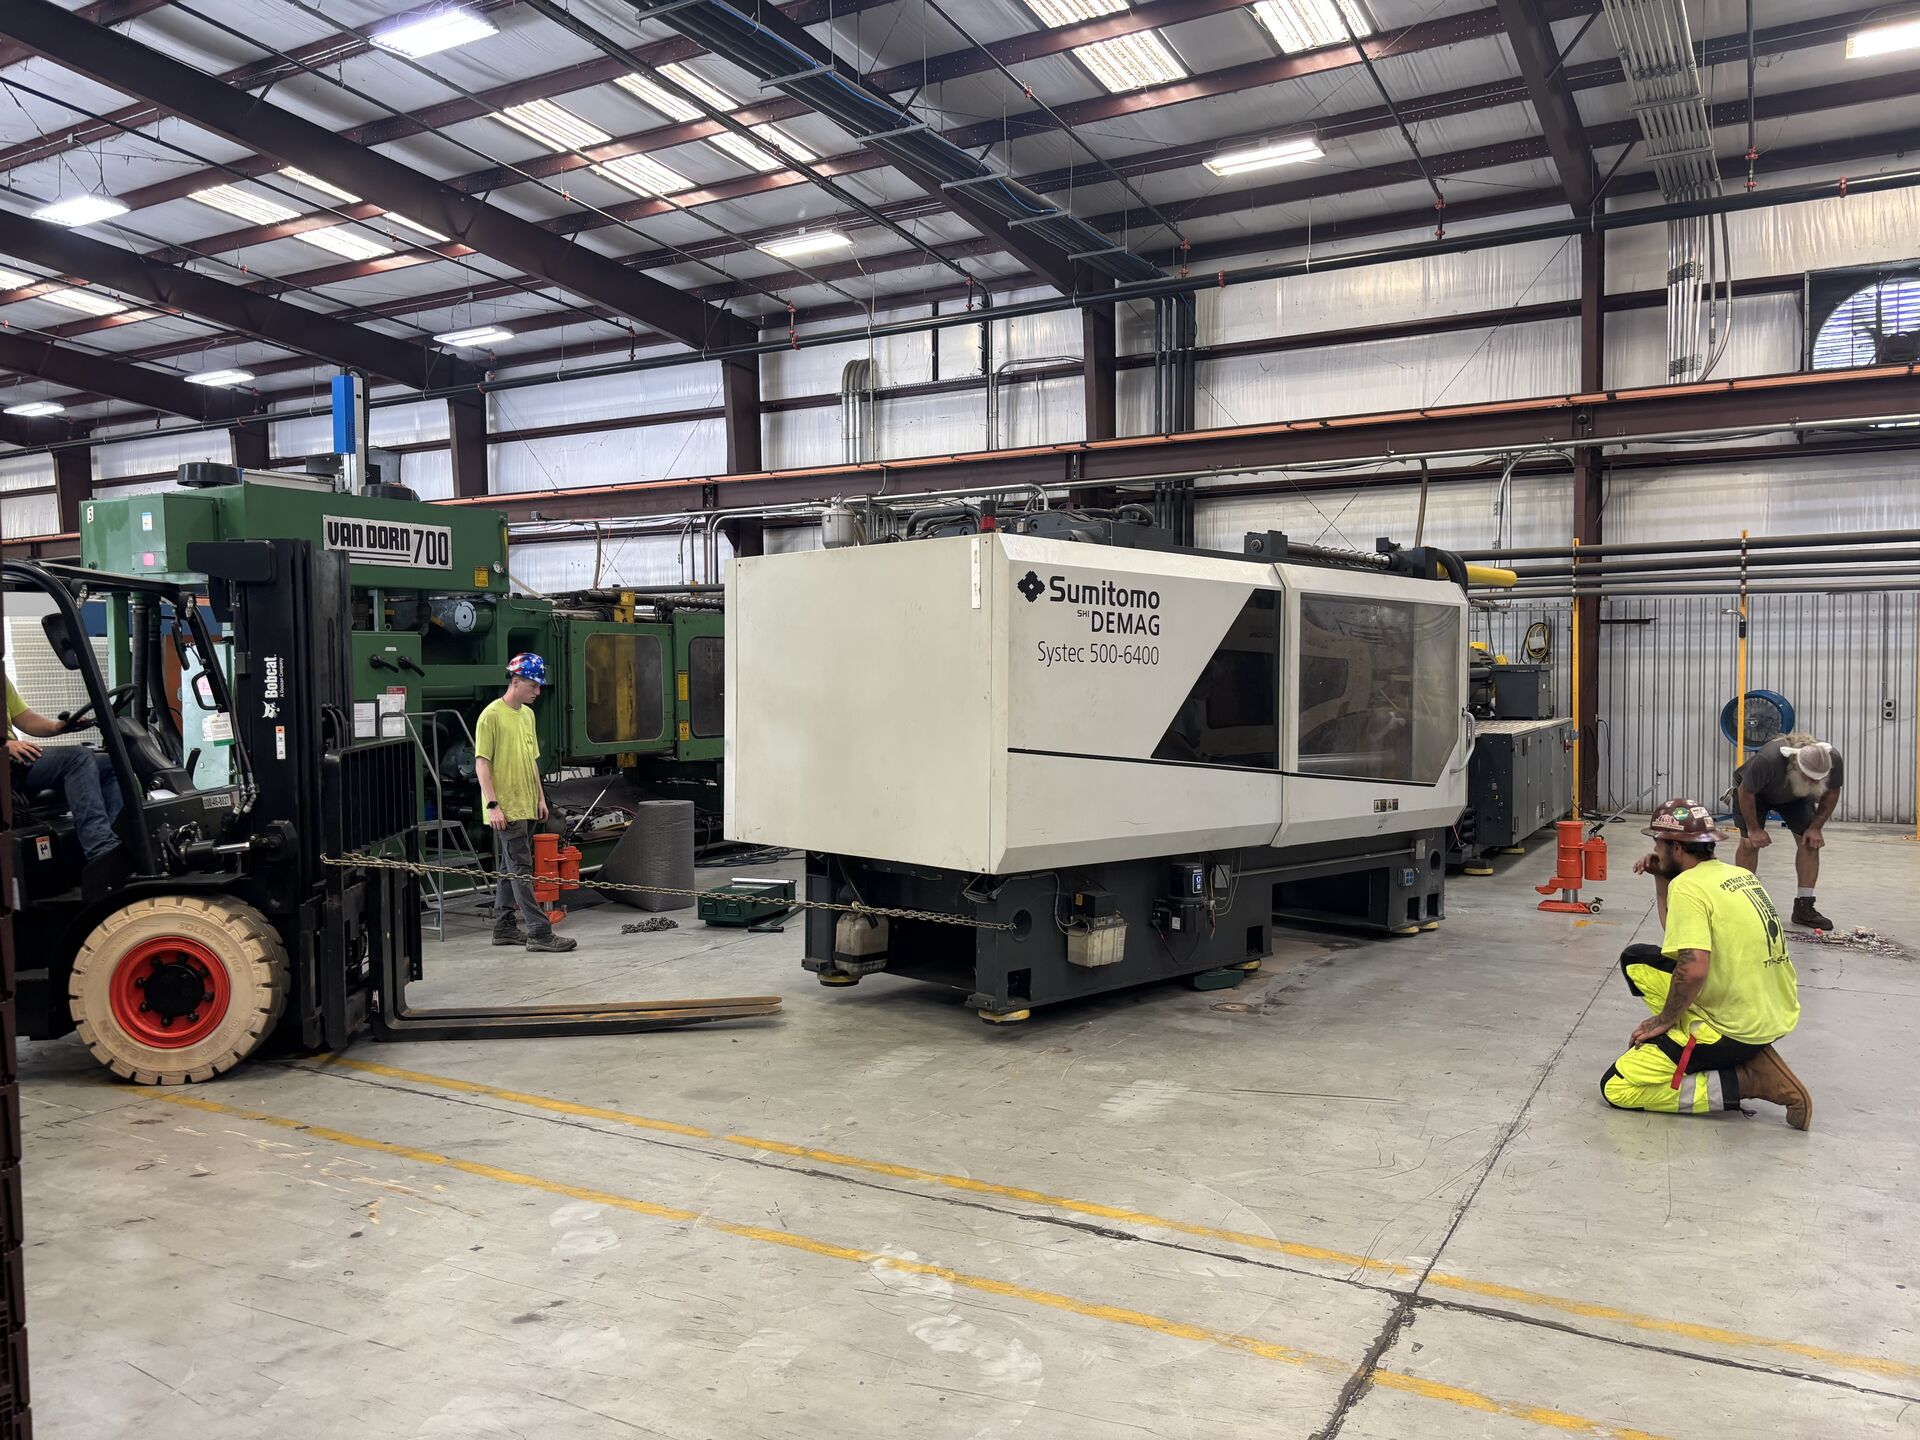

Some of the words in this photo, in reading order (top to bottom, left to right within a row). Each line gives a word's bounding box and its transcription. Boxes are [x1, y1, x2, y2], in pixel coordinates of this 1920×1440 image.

[327, 521, 363, 548] VAN
[366, 525, 411, 552] DORN
[413, 529, 449, 566] 700
[1049, 576, 1161, 610] Sumitomo
[1077, 610, 1090, 618] SHI
[1091, 611, 1160, 636] DEMAG
[1037, 641, 1085, 668] Systec
[1090, 643, 1159, 666] 500-6400
[263, 656, 279, 698] Bobcat
[1719, 876, 1744, 891] PATRIOT
